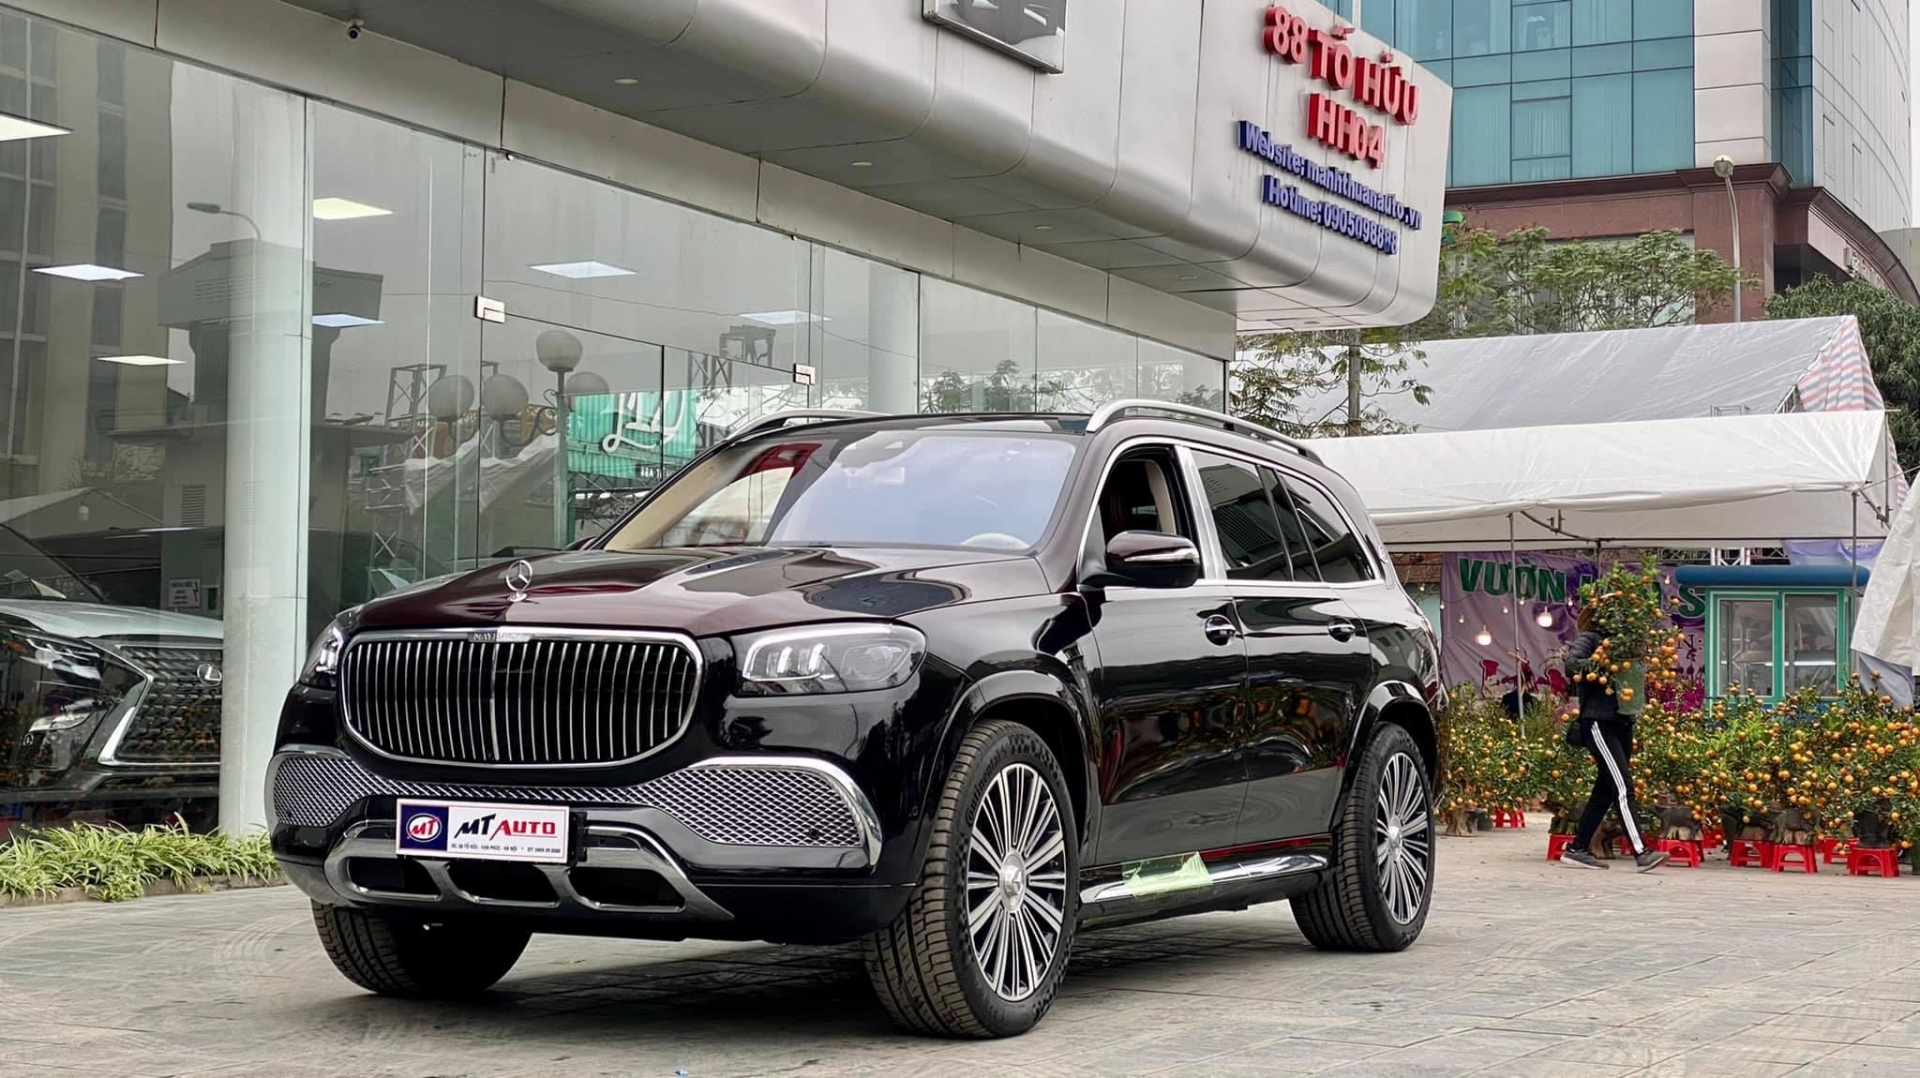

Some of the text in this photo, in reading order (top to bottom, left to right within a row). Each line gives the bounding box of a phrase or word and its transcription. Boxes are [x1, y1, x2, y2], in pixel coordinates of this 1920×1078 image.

[1263, 6, 1306, 64] 88
[1308, 26, 1354, 91] TỐ
[1238, 120, 1306, 173] Website:
[1307, 93, 1384, 169] HH04
[1263, 174, 1321, 226] Hotline:
[1458, 556, 1567, 603] VƯỜN
[454, 813, 497, 839] MT
